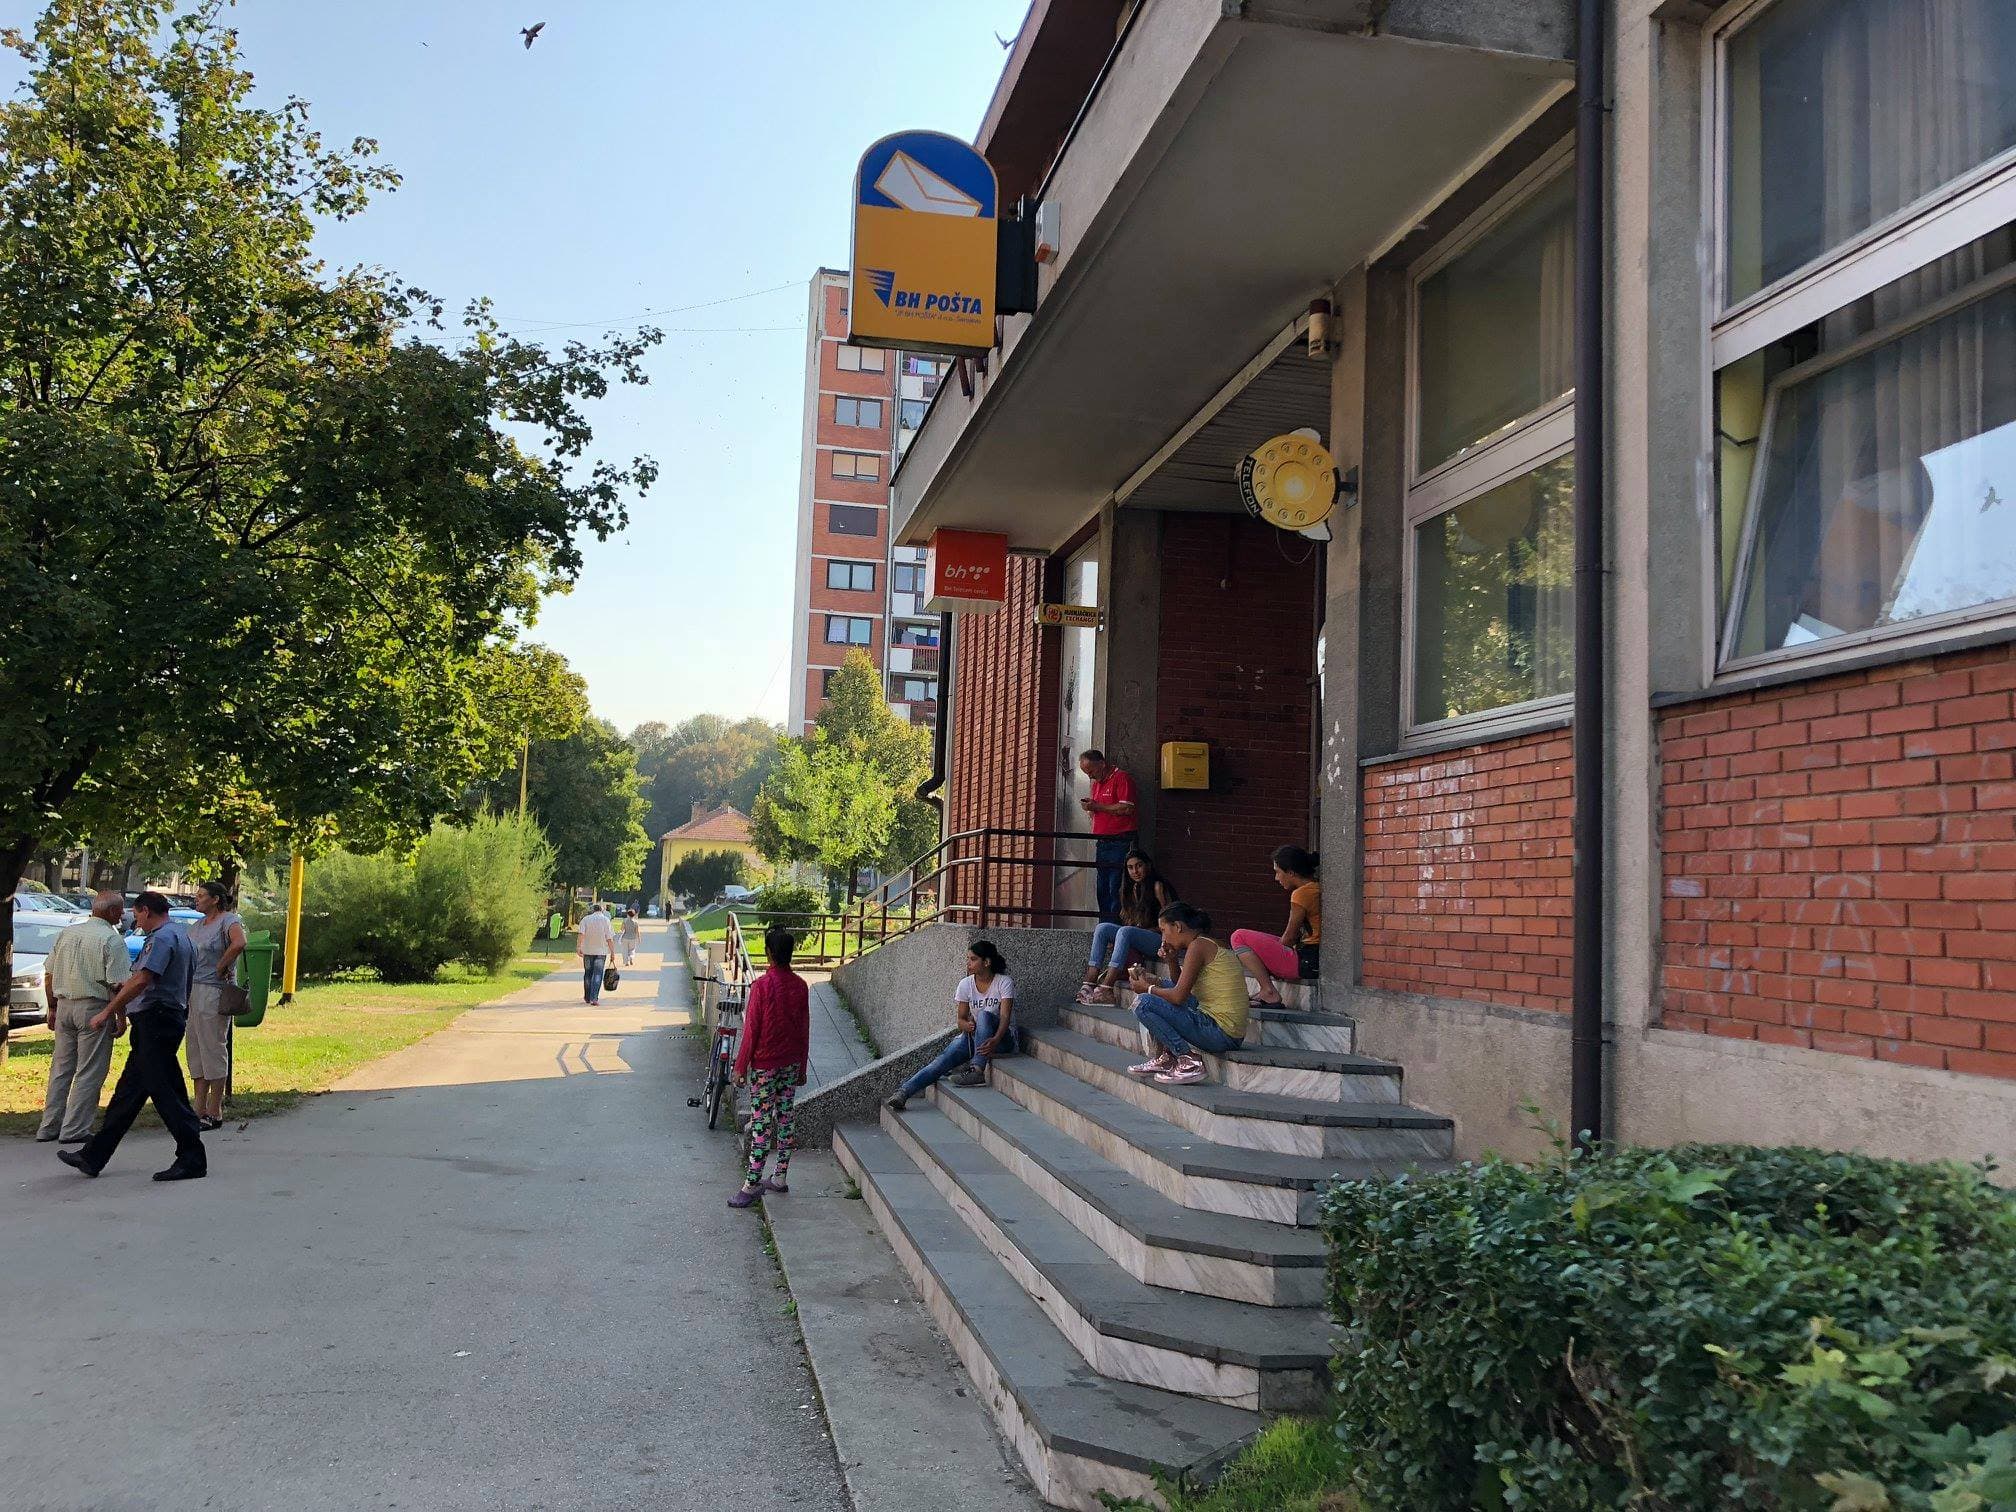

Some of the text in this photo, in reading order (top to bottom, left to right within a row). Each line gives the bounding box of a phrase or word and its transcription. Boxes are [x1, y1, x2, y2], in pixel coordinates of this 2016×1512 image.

[895, 290, 982, 315] BH POŠTA
[1241, 458, 1260, 514] TELEFON
